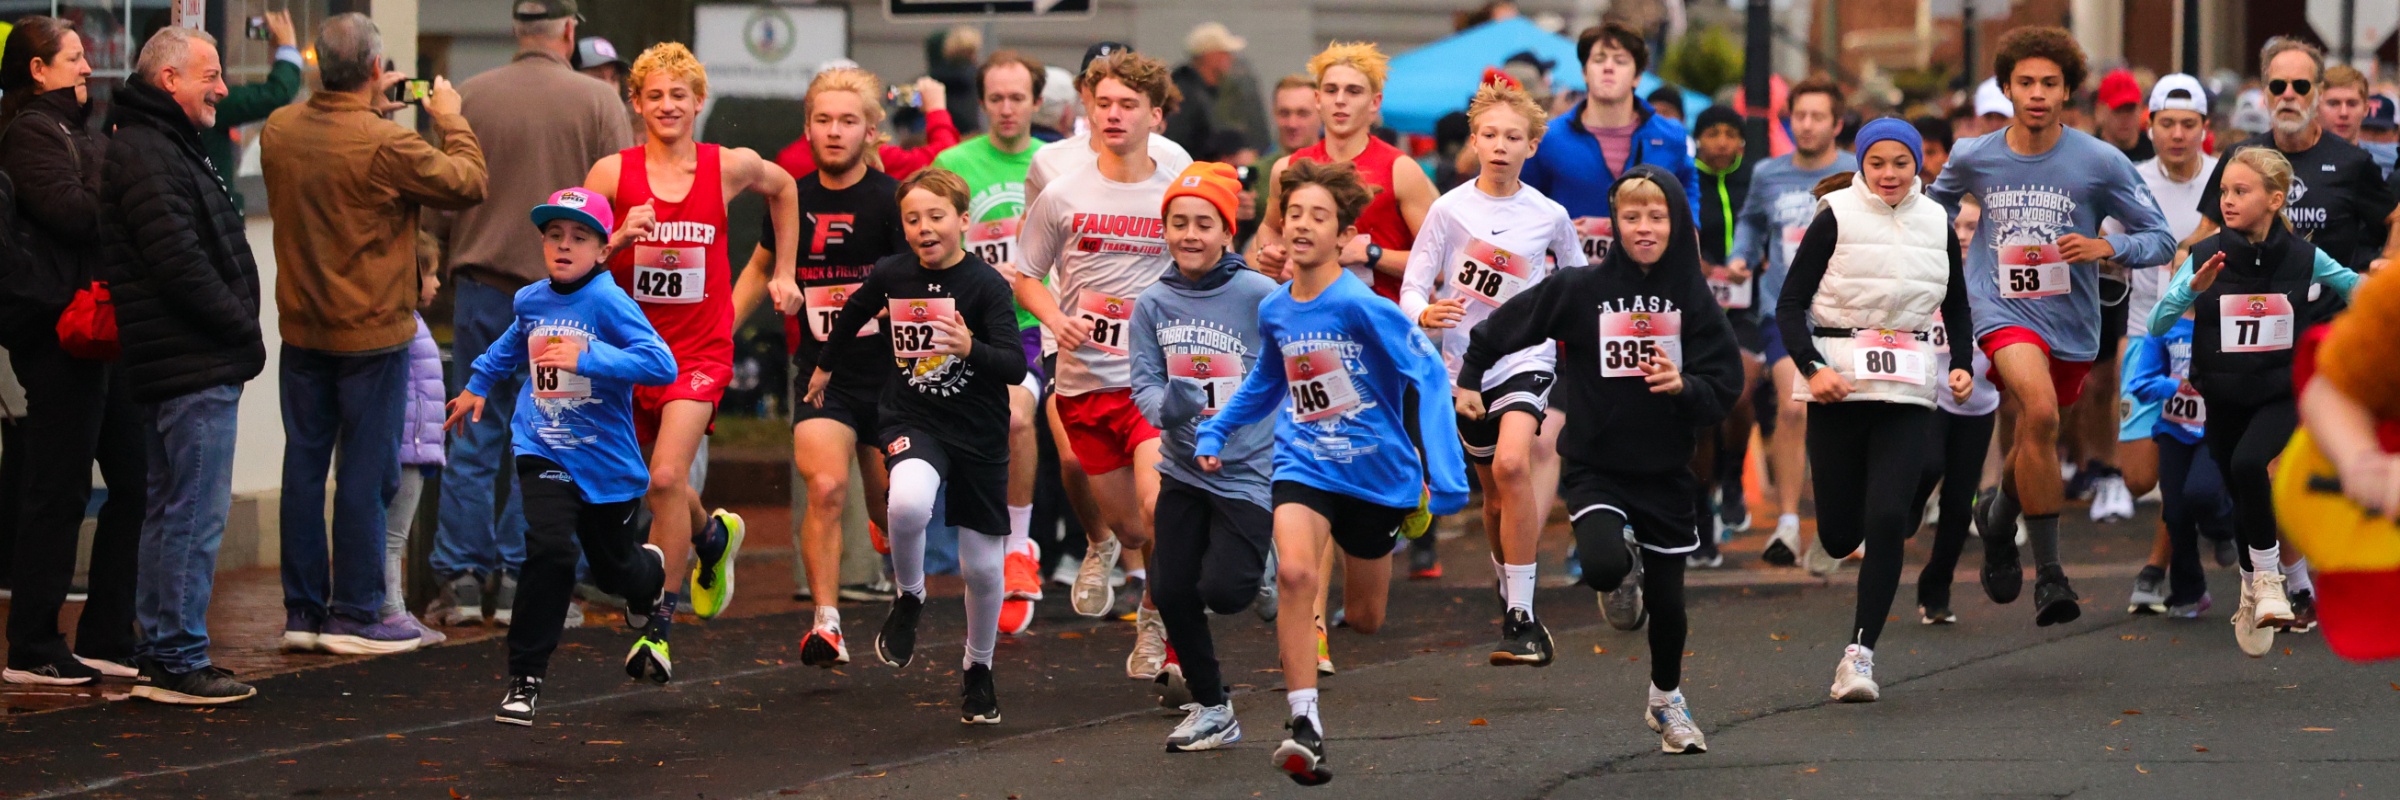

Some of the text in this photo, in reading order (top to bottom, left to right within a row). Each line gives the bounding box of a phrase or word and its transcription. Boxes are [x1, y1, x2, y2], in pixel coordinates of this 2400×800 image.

[2028, 192, 2068, 213] GOBBLE
[2009, 208, 2021, 220] OR
[2022, 207, 2063, 225] WOBBLE
[634, 221, 716, 245] UQUIER
[808, 212, 855, 259] F
[1103, 242, 1131, 254] TRACK
[1139, 244, 1163, 255] FIELD
[637, 270, 682, 297] 428
[797, 265, 825, 280] TRACK
[836, 264, 859, 278] FIELD
[1458, 260, 1503, 297] 318
[2009, 268, 2040, 292] 53
[893, 325, 935, 351] 532
[1197, 326, 1241, 355] GOBBLE
[2235, 320, 2260, 345] 77
[1605, 340, 1656, 370] 335
[1866, 350, 1897, 374] 80
[536, 364, 558, 391] 83
[897, 364, 976, 397] TOURNAME
[1291, 381, 1331, 415] 246
